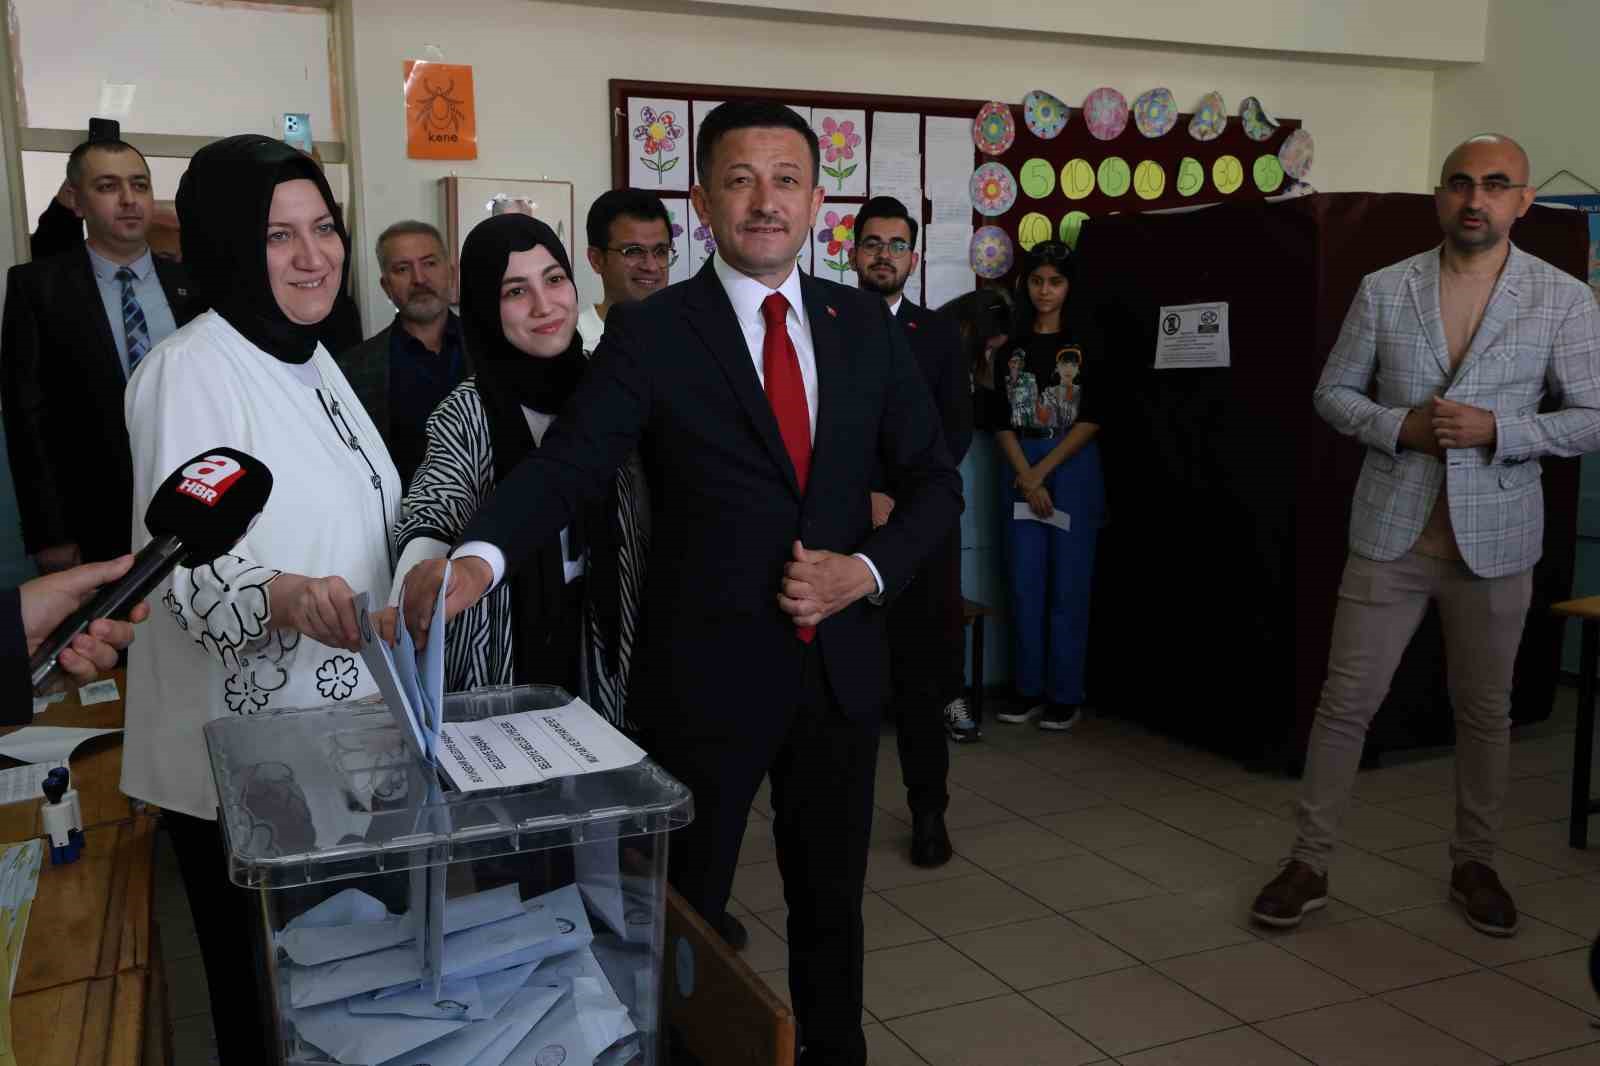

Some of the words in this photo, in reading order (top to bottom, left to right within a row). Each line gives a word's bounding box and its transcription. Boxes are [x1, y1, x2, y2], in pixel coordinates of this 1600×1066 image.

[428, 132, 458, 142] kene
[1066, 160, 1091, 192] 10
[179, 480, 218, 502] HBR
